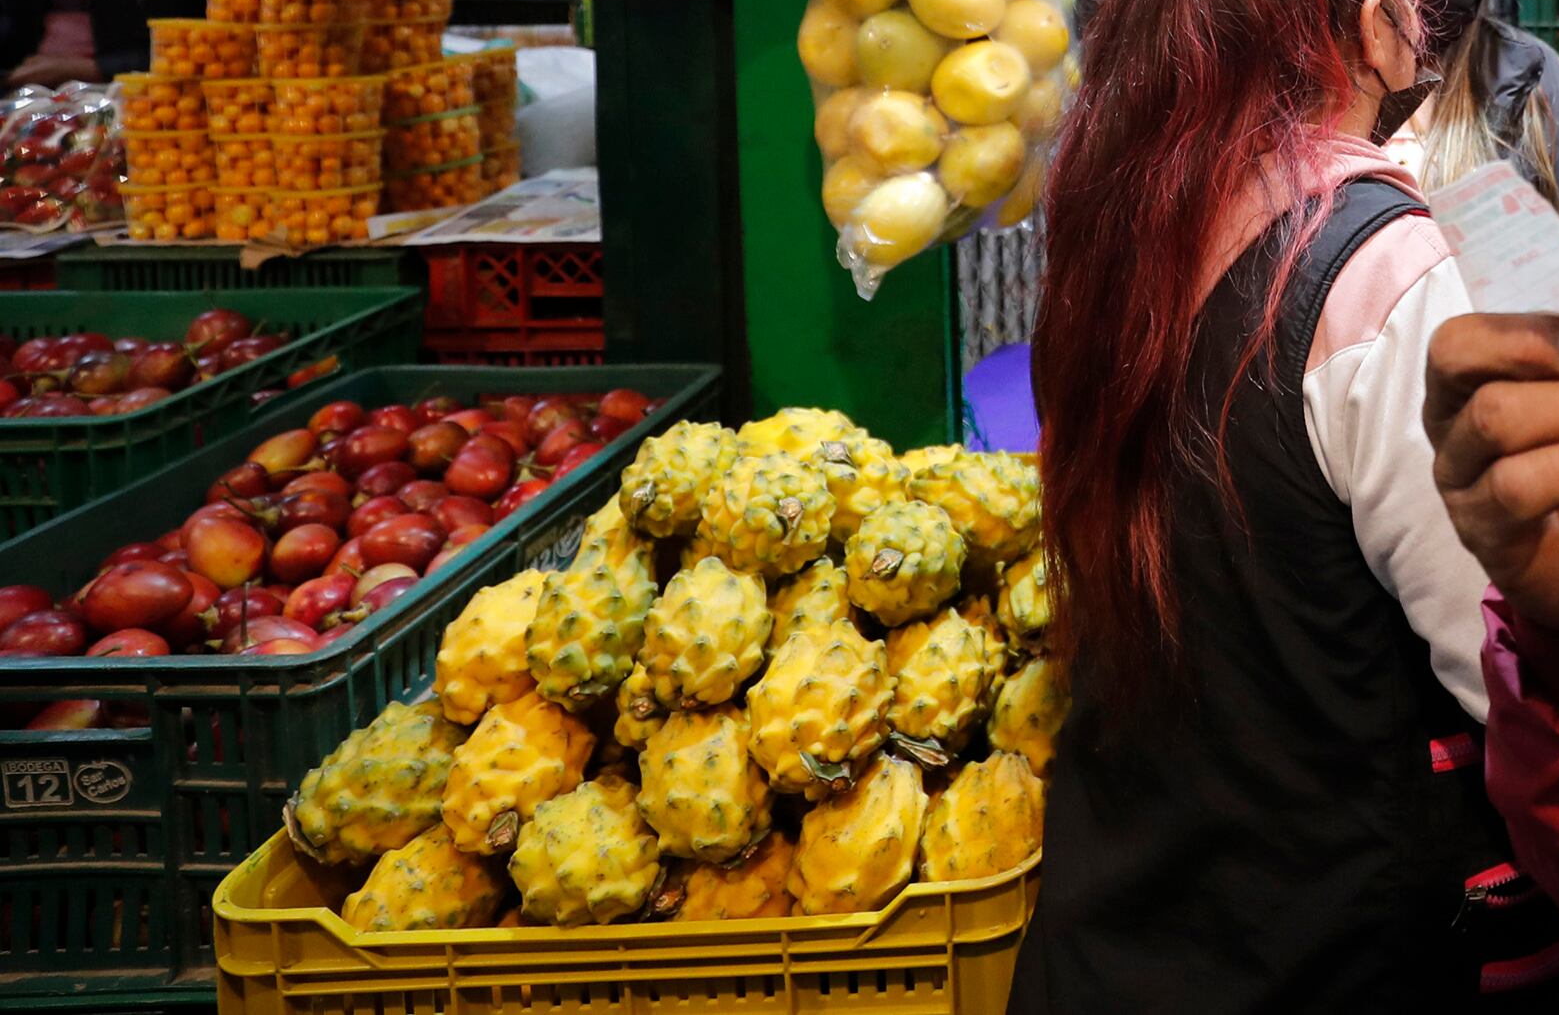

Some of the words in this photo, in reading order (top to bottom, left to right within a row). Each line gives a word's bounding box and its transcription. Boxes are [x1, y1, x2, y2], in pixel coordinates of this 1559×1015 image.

[8, 761, 62, 772] BODEGA
[81, 771, 104, 786] San
[88, 776, 126, 797] Carlos
[17, 774, 62, 803] 12
